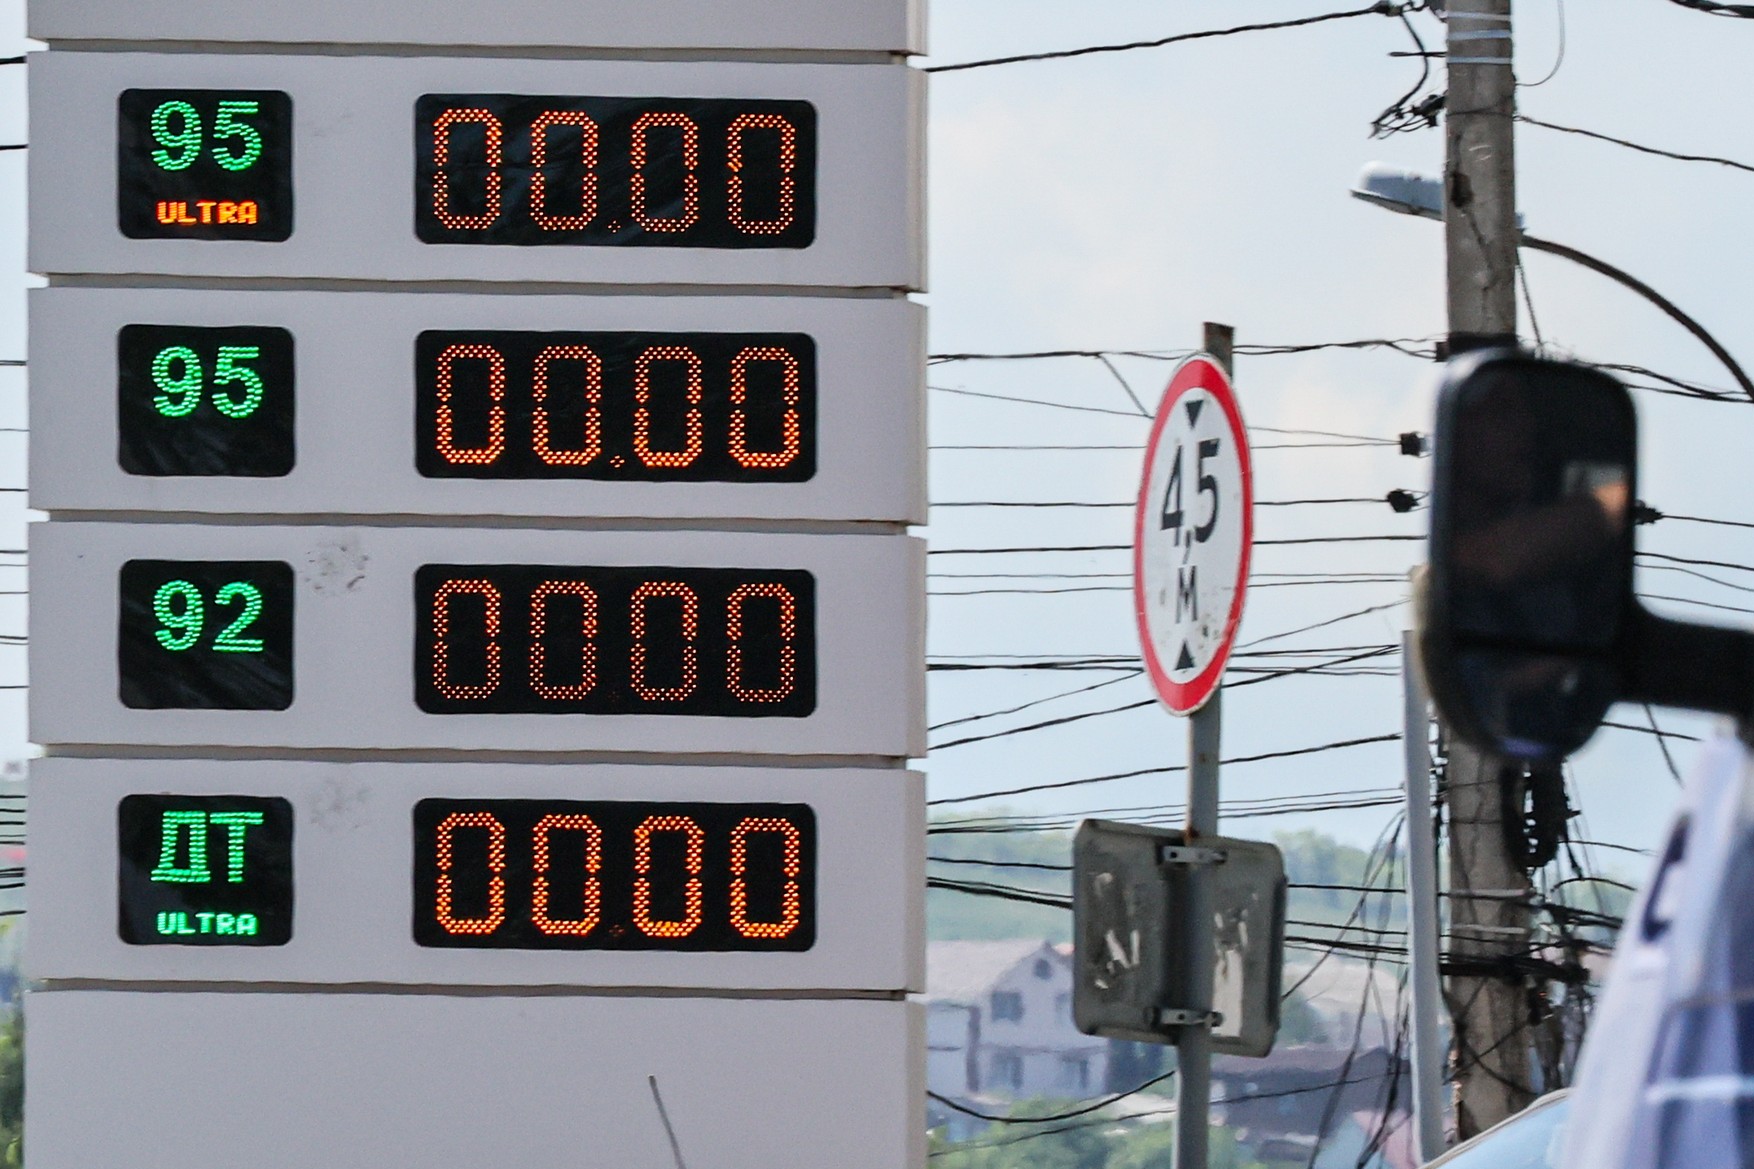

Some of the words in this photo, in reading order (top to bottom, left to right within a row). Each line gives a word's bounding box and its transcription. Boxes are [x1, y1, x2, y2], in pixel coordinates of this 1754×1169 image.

[153, 100, 263, 172] 95
[156, 200, 259, 226] ULTRA
[153, 345, 264, 419] 95
[1160, 437, 1221, 566] 4,5
[153, 579, 264, 653] 92
[151, 810, 264, 883] ДТ
[157, 911, 259, 936] ULTRA
